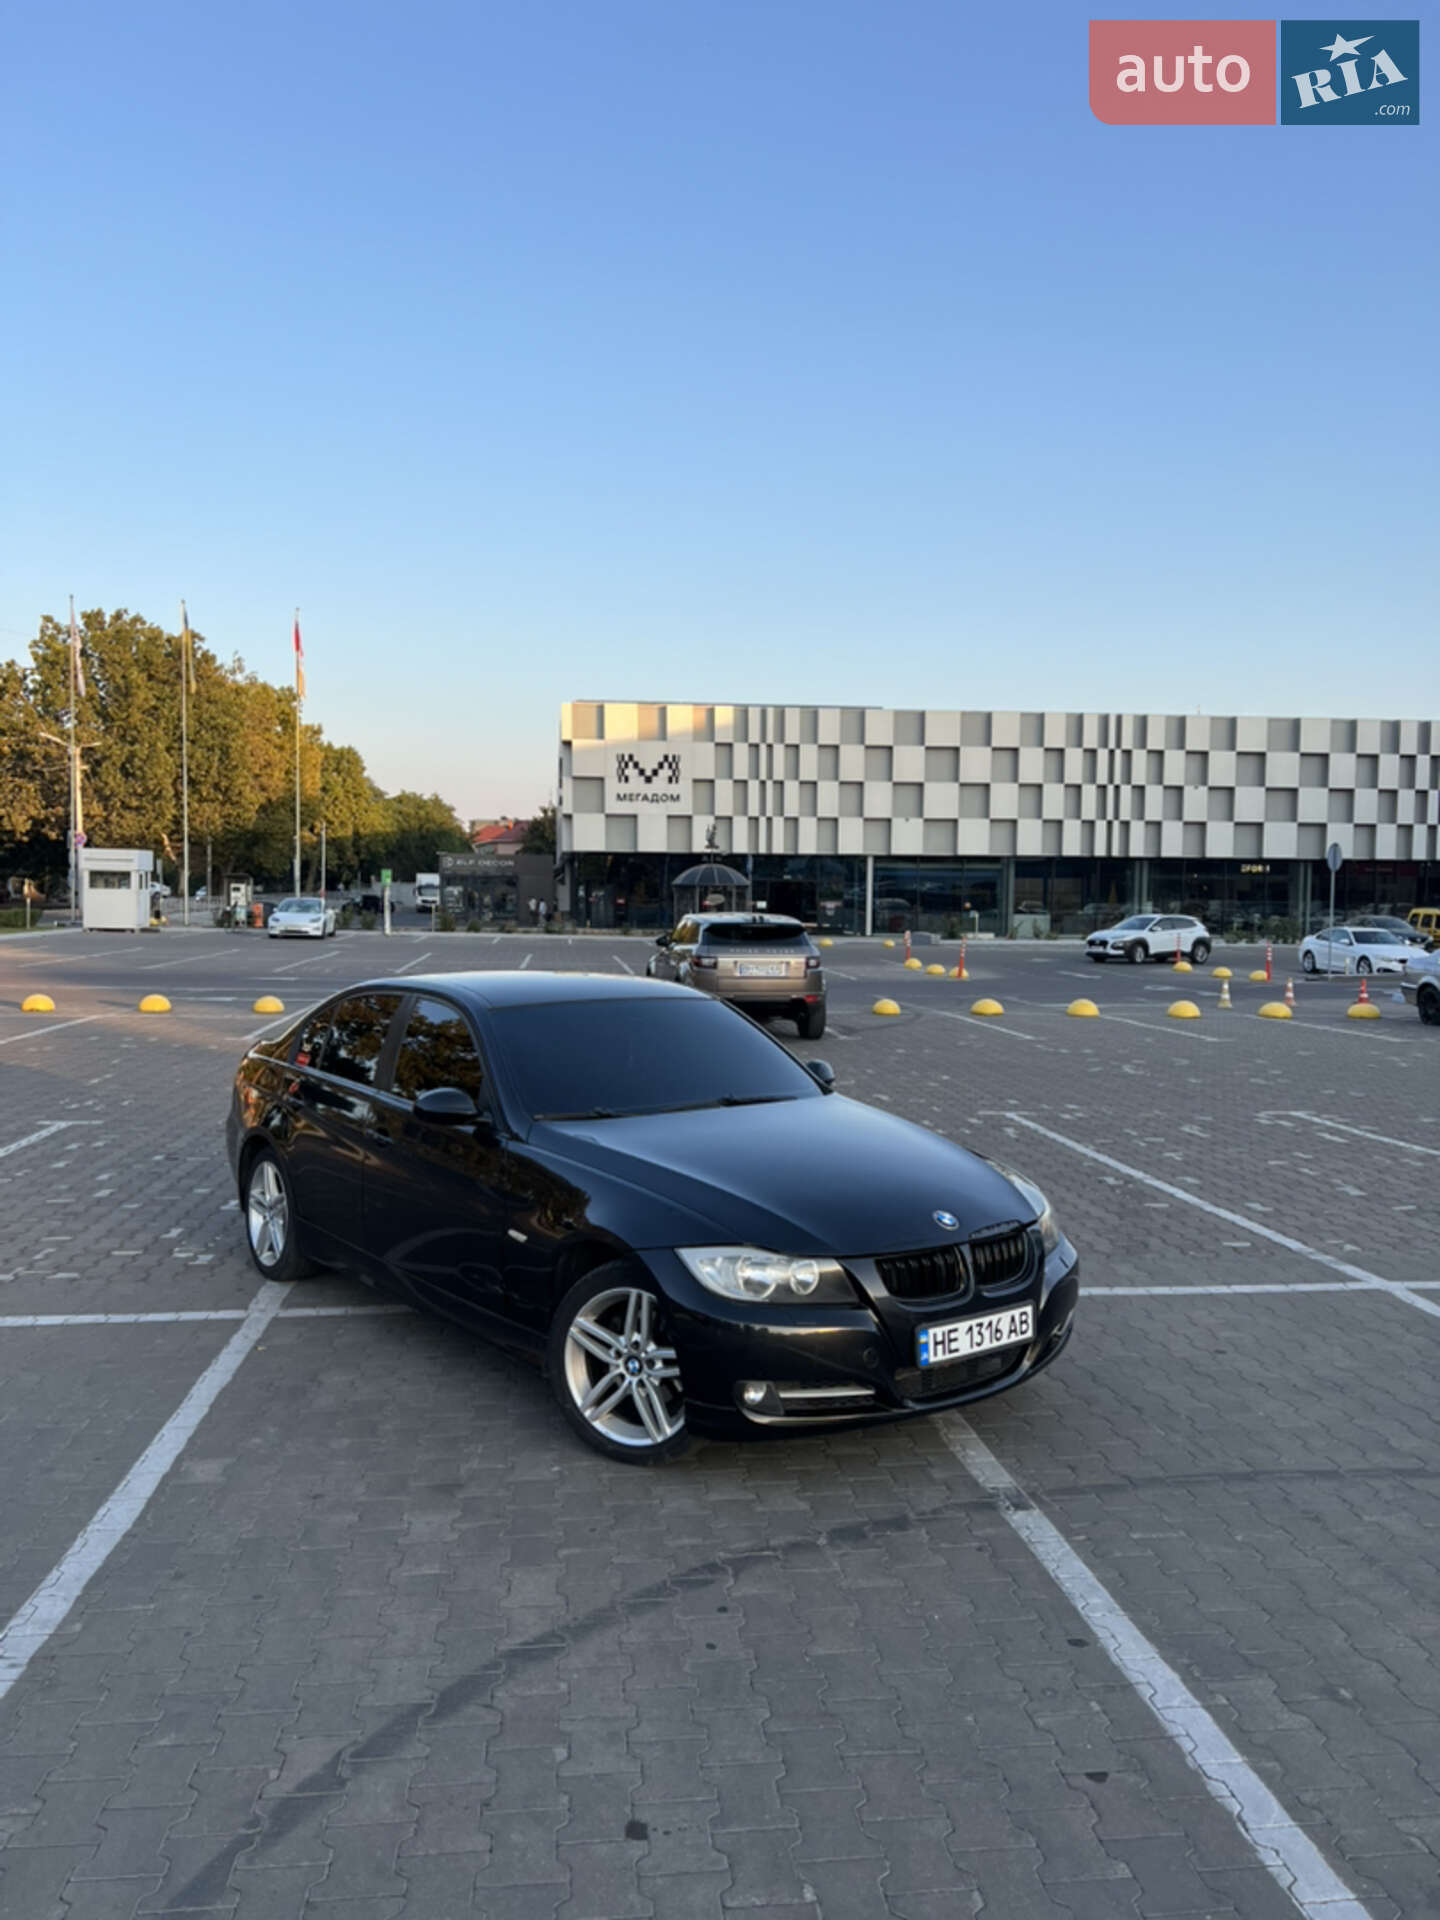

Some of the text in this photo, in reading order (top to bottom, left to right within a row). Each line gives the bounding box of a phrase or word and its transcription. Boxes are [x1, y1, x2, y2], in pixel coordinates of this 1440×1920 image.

[616, 793, 681, 804] МЕГАДОМ
[932, 1310, 1030, 1358] HE 1316 AB
